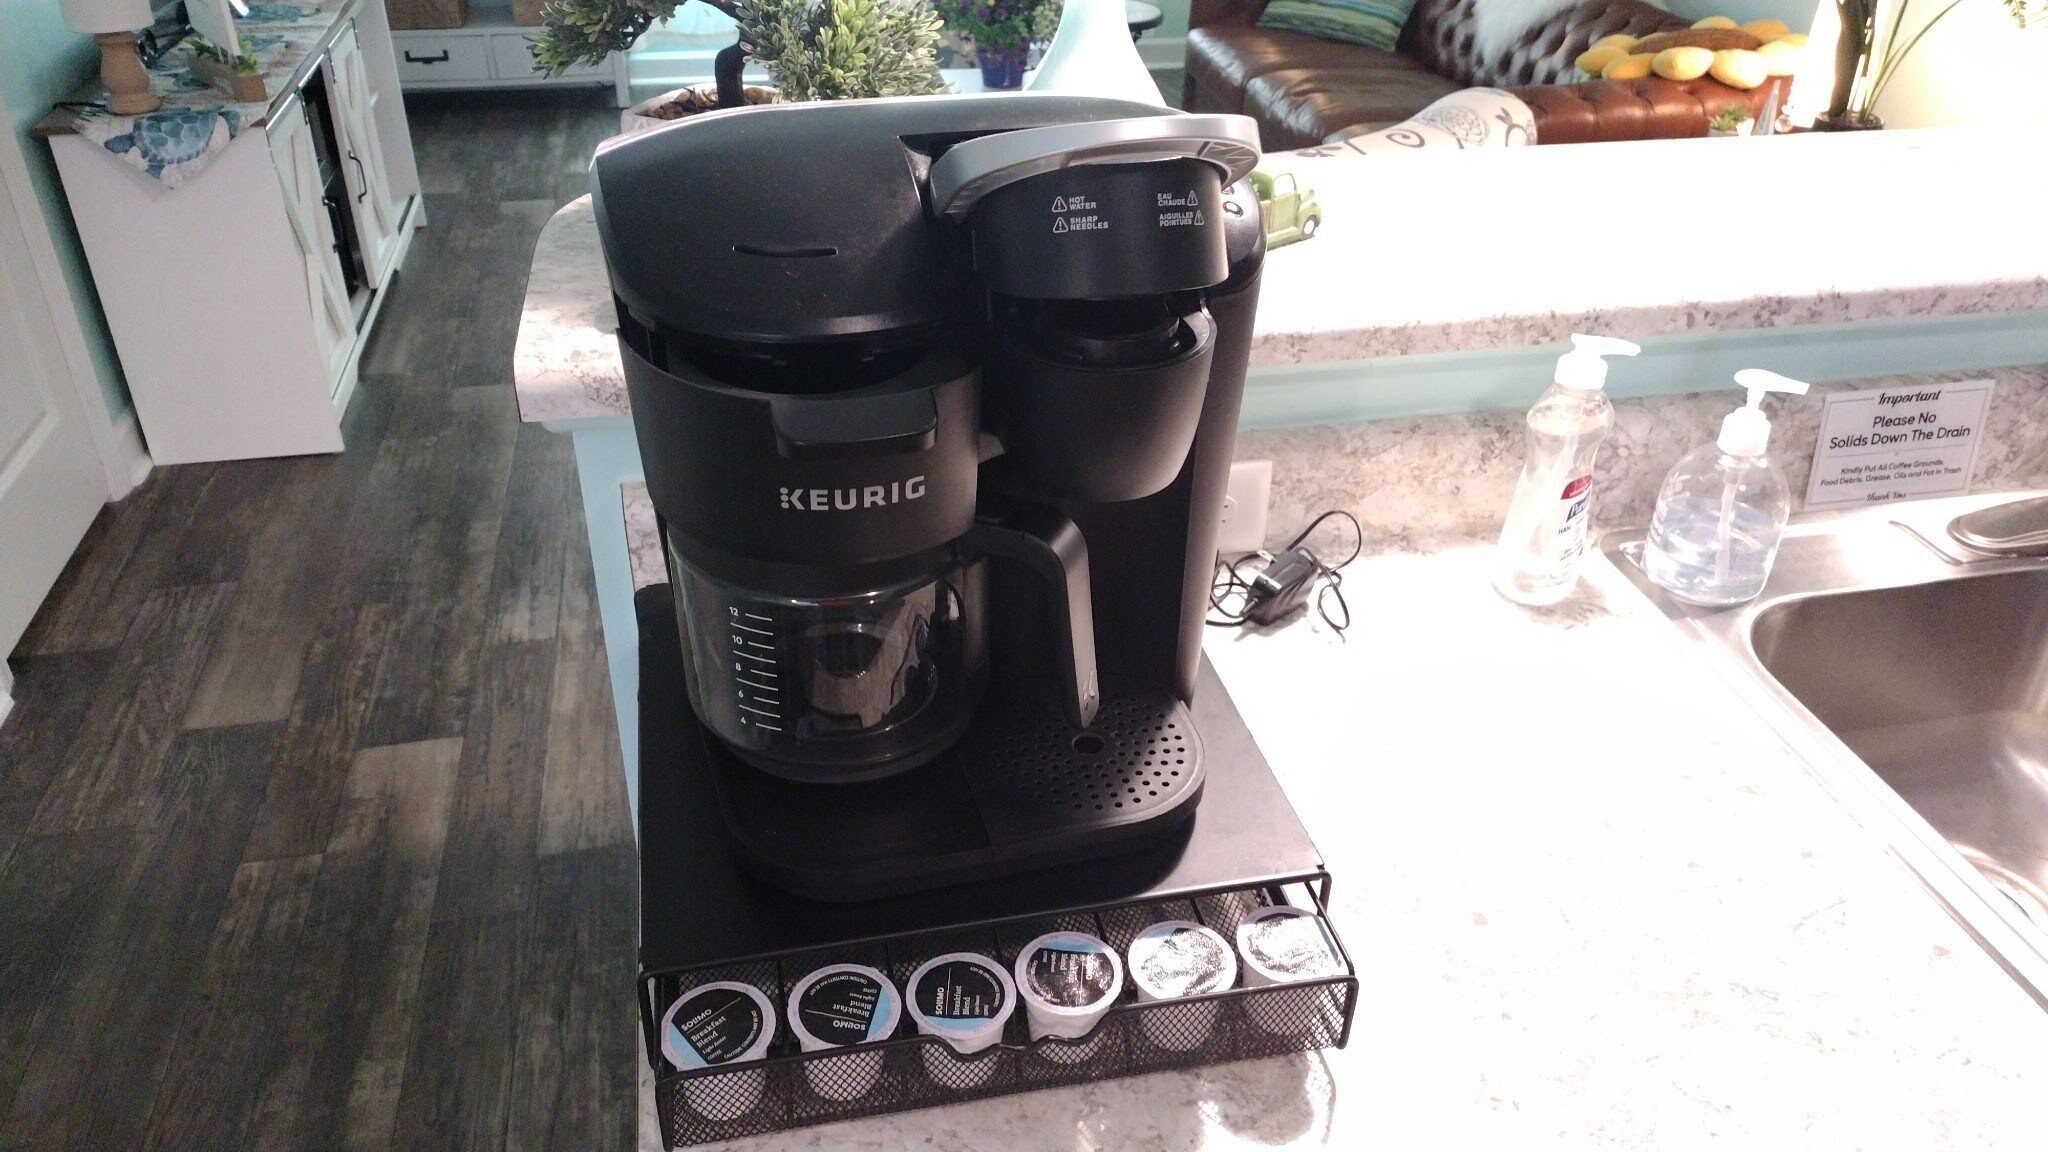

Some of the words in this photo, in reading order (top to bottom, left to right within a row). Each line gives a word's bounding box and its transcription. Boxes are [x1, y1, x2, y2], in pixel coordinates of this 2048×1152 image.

[1069, 202, 1097, 210] WATER
[1158, 199, 1186, 207] CHAUDE
[1159, 211, 1194, 221] AIGUILLES
[1070, 222, 1109, 231] NEEDLES
[1159, 218, 1193, 227] POINTUES
[1878, 388, 1942, 407] Important
[1872, 415, 1916, 428] Please
[1918, 412, 1937, 424] No
[1829, 433, 1868, 450] Solids
[1871, 432, 1908, 446] Down
[1911, 429, 1934, 442] The
[1936, 426, 1971, 439] Drain
[1841, 465, 1864, 475] Kindly
[1864, 464, 1877, 473] Put
[1877, 463, 1888, 471] All
[1888, 461, 1912, 471] Coffee
[1820, 479, 1839, 487] Food
[1907, 470, 1922, 479] and
[1922, 469, 1935, 477] Fat
[1943, 466, 1962, 475] Trash
[779, 475, 926, 511] KEURIG
[1866, 490, 1891, 501] Thank
[729, 606, 739, 617] 12
[732, 635, 743, 645] 10
[735, 662, 742, 671] 8
[738, 690, 744, 698] 6
[740, 716, 747, 724] 4
[832, 1003, 871, 1018] Breakfast
[849, 1000, 872, 1010] Blend
[691, 1015, 727, 1042] Breakfast
[696, 1030, 718, 1048] Blend
